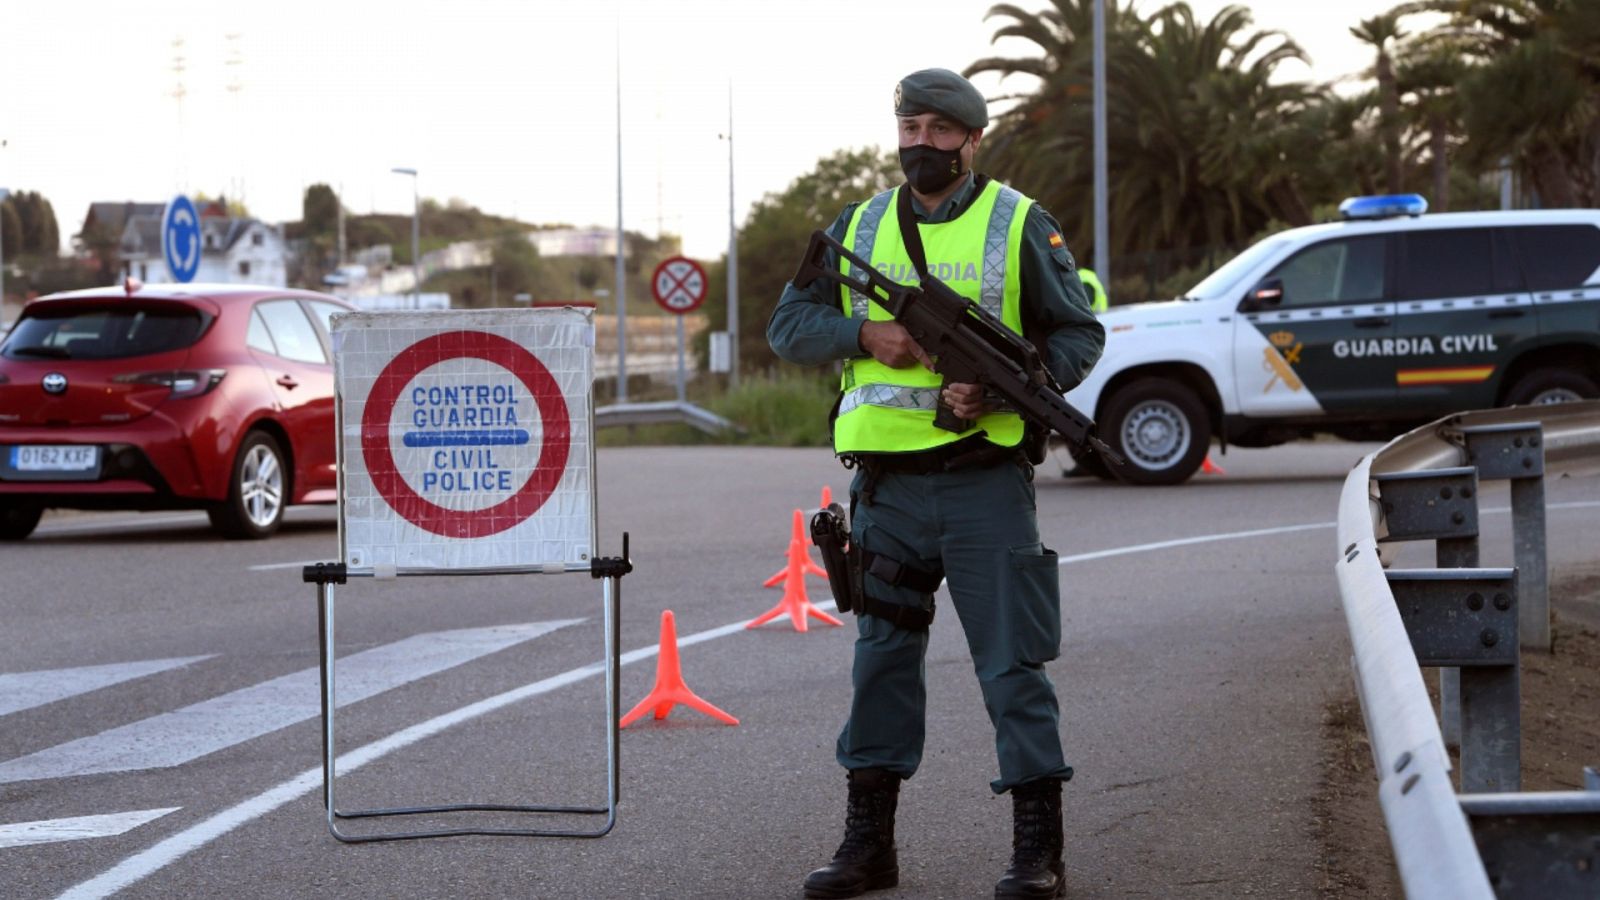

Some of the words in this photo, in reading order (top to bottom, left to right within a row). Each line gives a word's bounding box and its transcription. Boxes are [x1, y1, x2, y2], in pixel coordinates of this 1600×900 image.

[1333, 337, 1434, 358] GUARDIA
[1440, 334, 1498, 353] CIVIL
[412, 385, 518, 406] CONTROL
[413, 407, 518, 428] GUARDIA
[22, 447, 60, 464] 0162
[64, 447, 91, 463] KXF
[434, 450, 498, 469] CIVIL
[423, 471, 512, 491] POLICE
